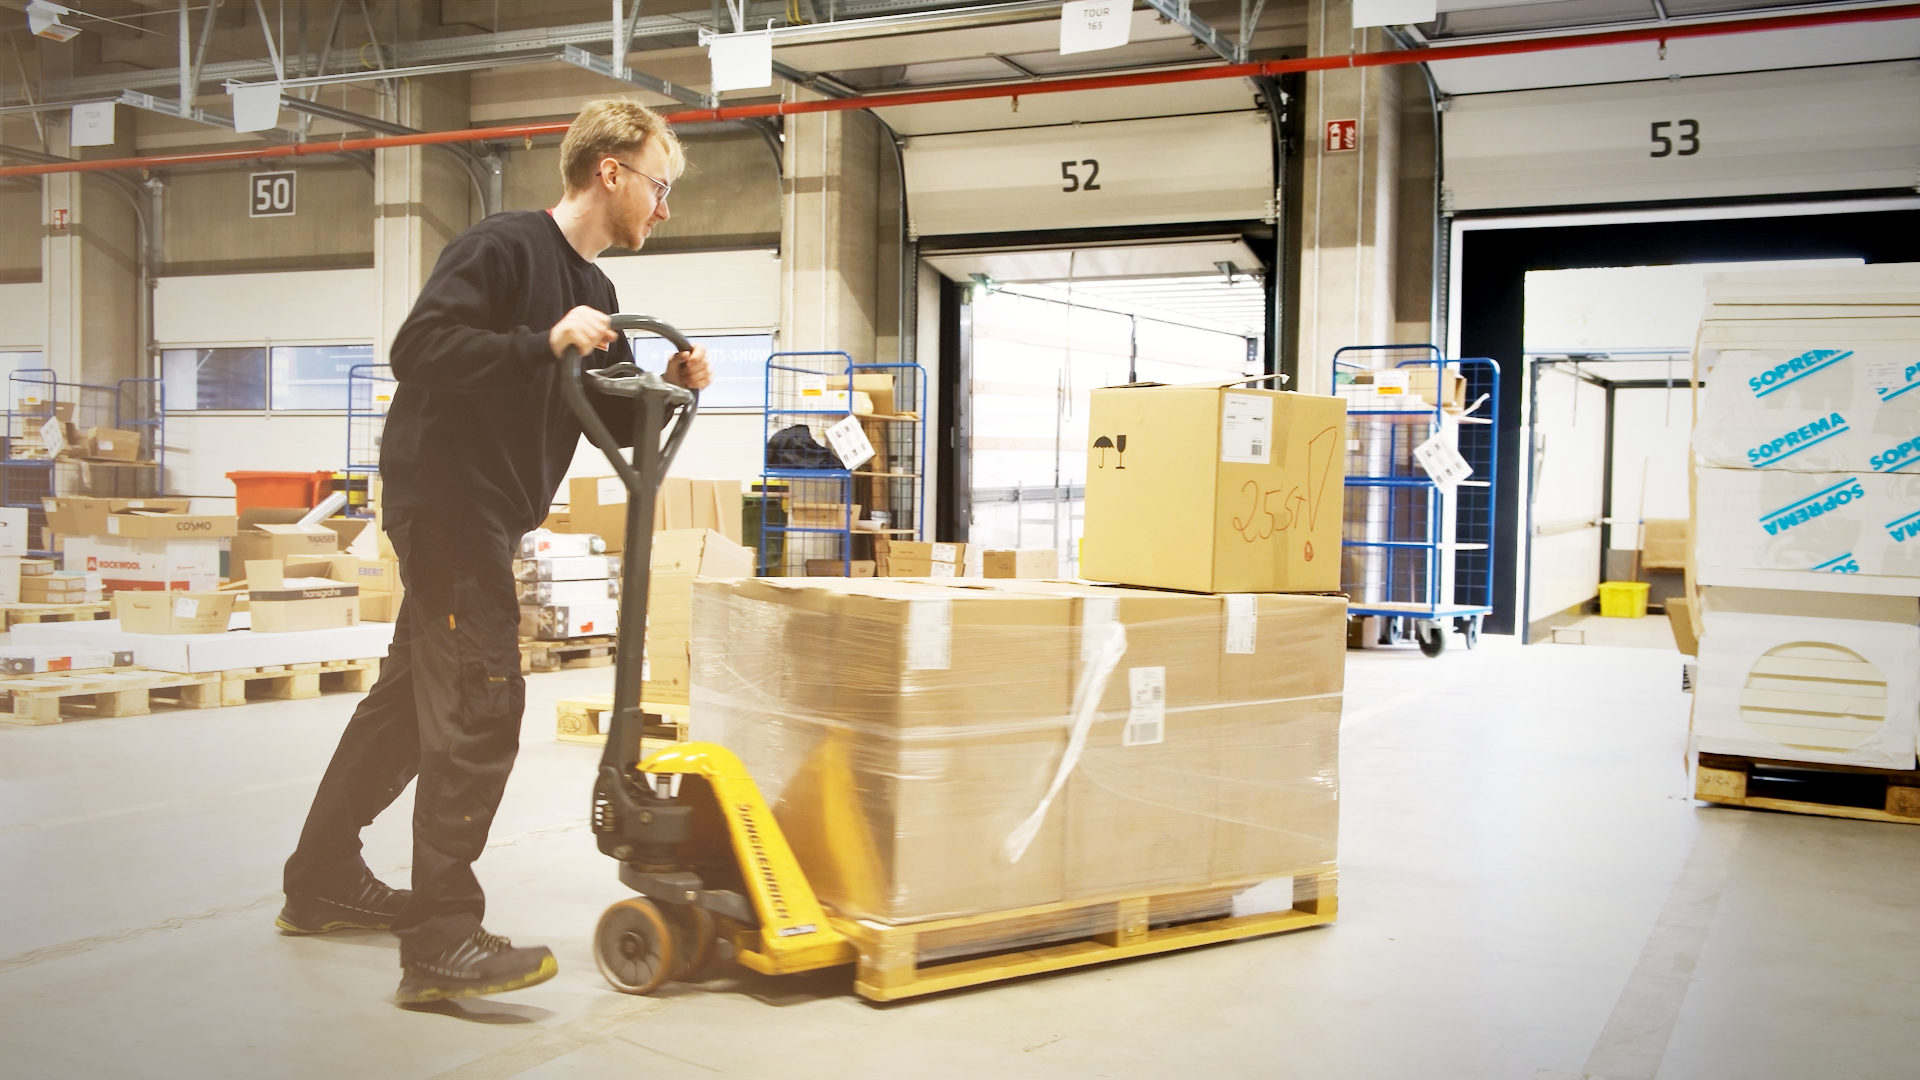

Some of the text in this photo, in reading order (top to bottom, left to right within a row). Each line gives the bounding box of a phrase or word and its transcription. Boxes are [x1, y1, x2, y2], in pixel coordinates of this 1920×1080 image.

[1083, 8, 1110, 18] TOUR
[1087, 21, 1103, 30] 165
[1649, 118, 1700, 158] 53
[1061, 158, 1101, 193] 52
[256, 177, 290, 211] 50
[1749, 350, 1842, 391] SOPREM
[1748, 412, 1846, 462] SOPREMA
[176, 521, 212, 531] COSMO
[1763, 483, 1865, 536] SOPREMA
[99, 560, 141, 570] ROCKWOOL
